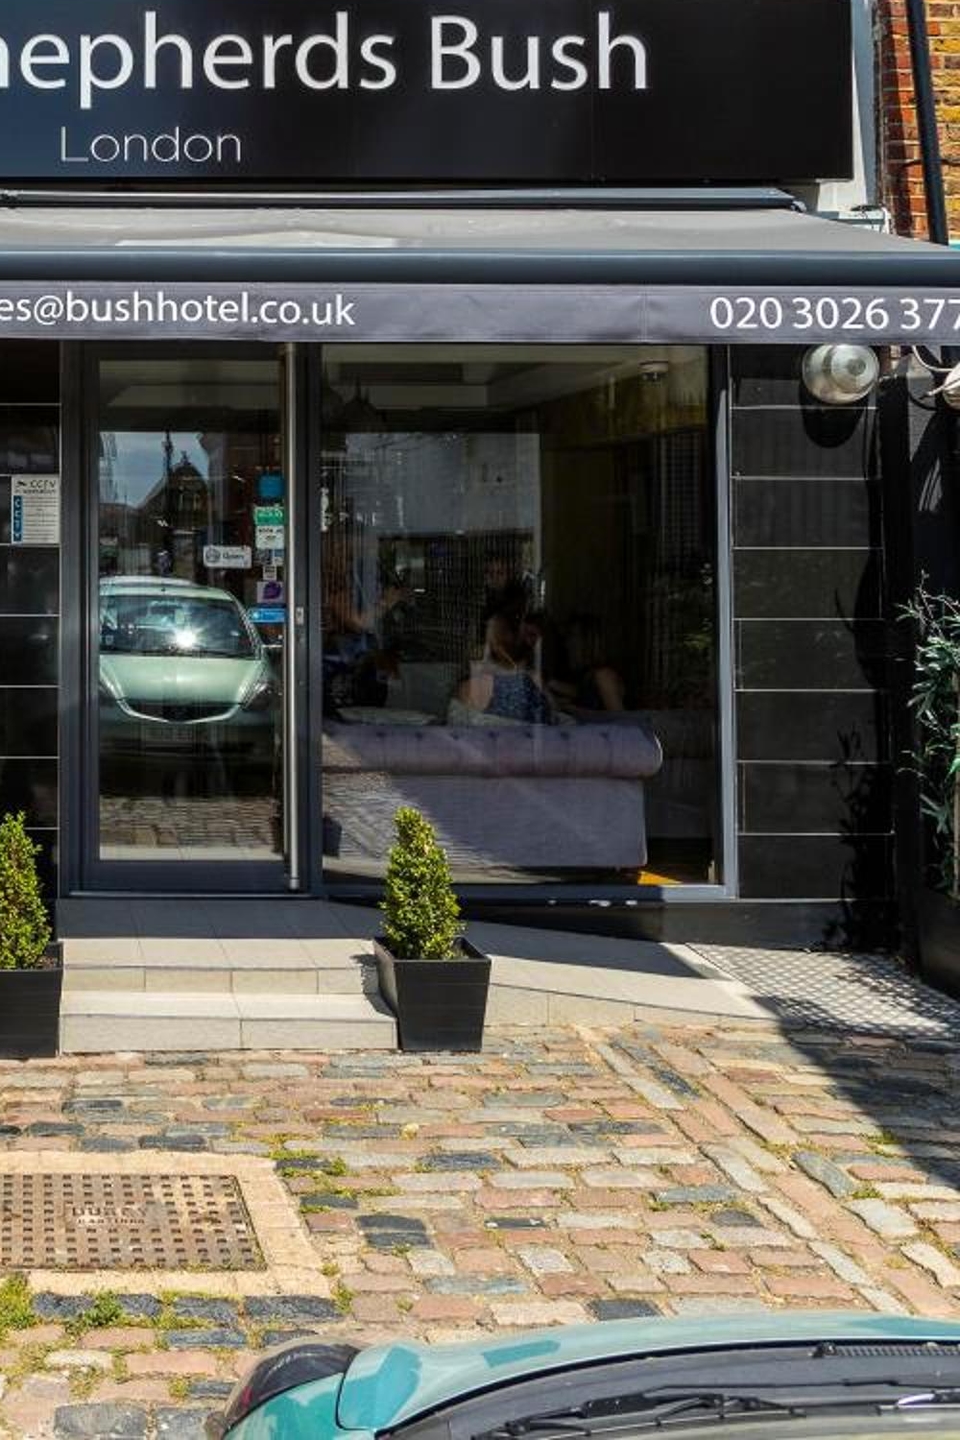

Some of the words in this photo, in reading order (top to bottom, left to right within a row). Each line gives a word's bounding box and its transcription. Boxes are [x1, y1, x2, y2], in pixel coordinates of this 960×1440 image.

[431, 11, 648, 91] Bush
[61, 126, 241, 162] London
[709, 296, 783, 329] 020
[792, 296, 889, 330] 3026
